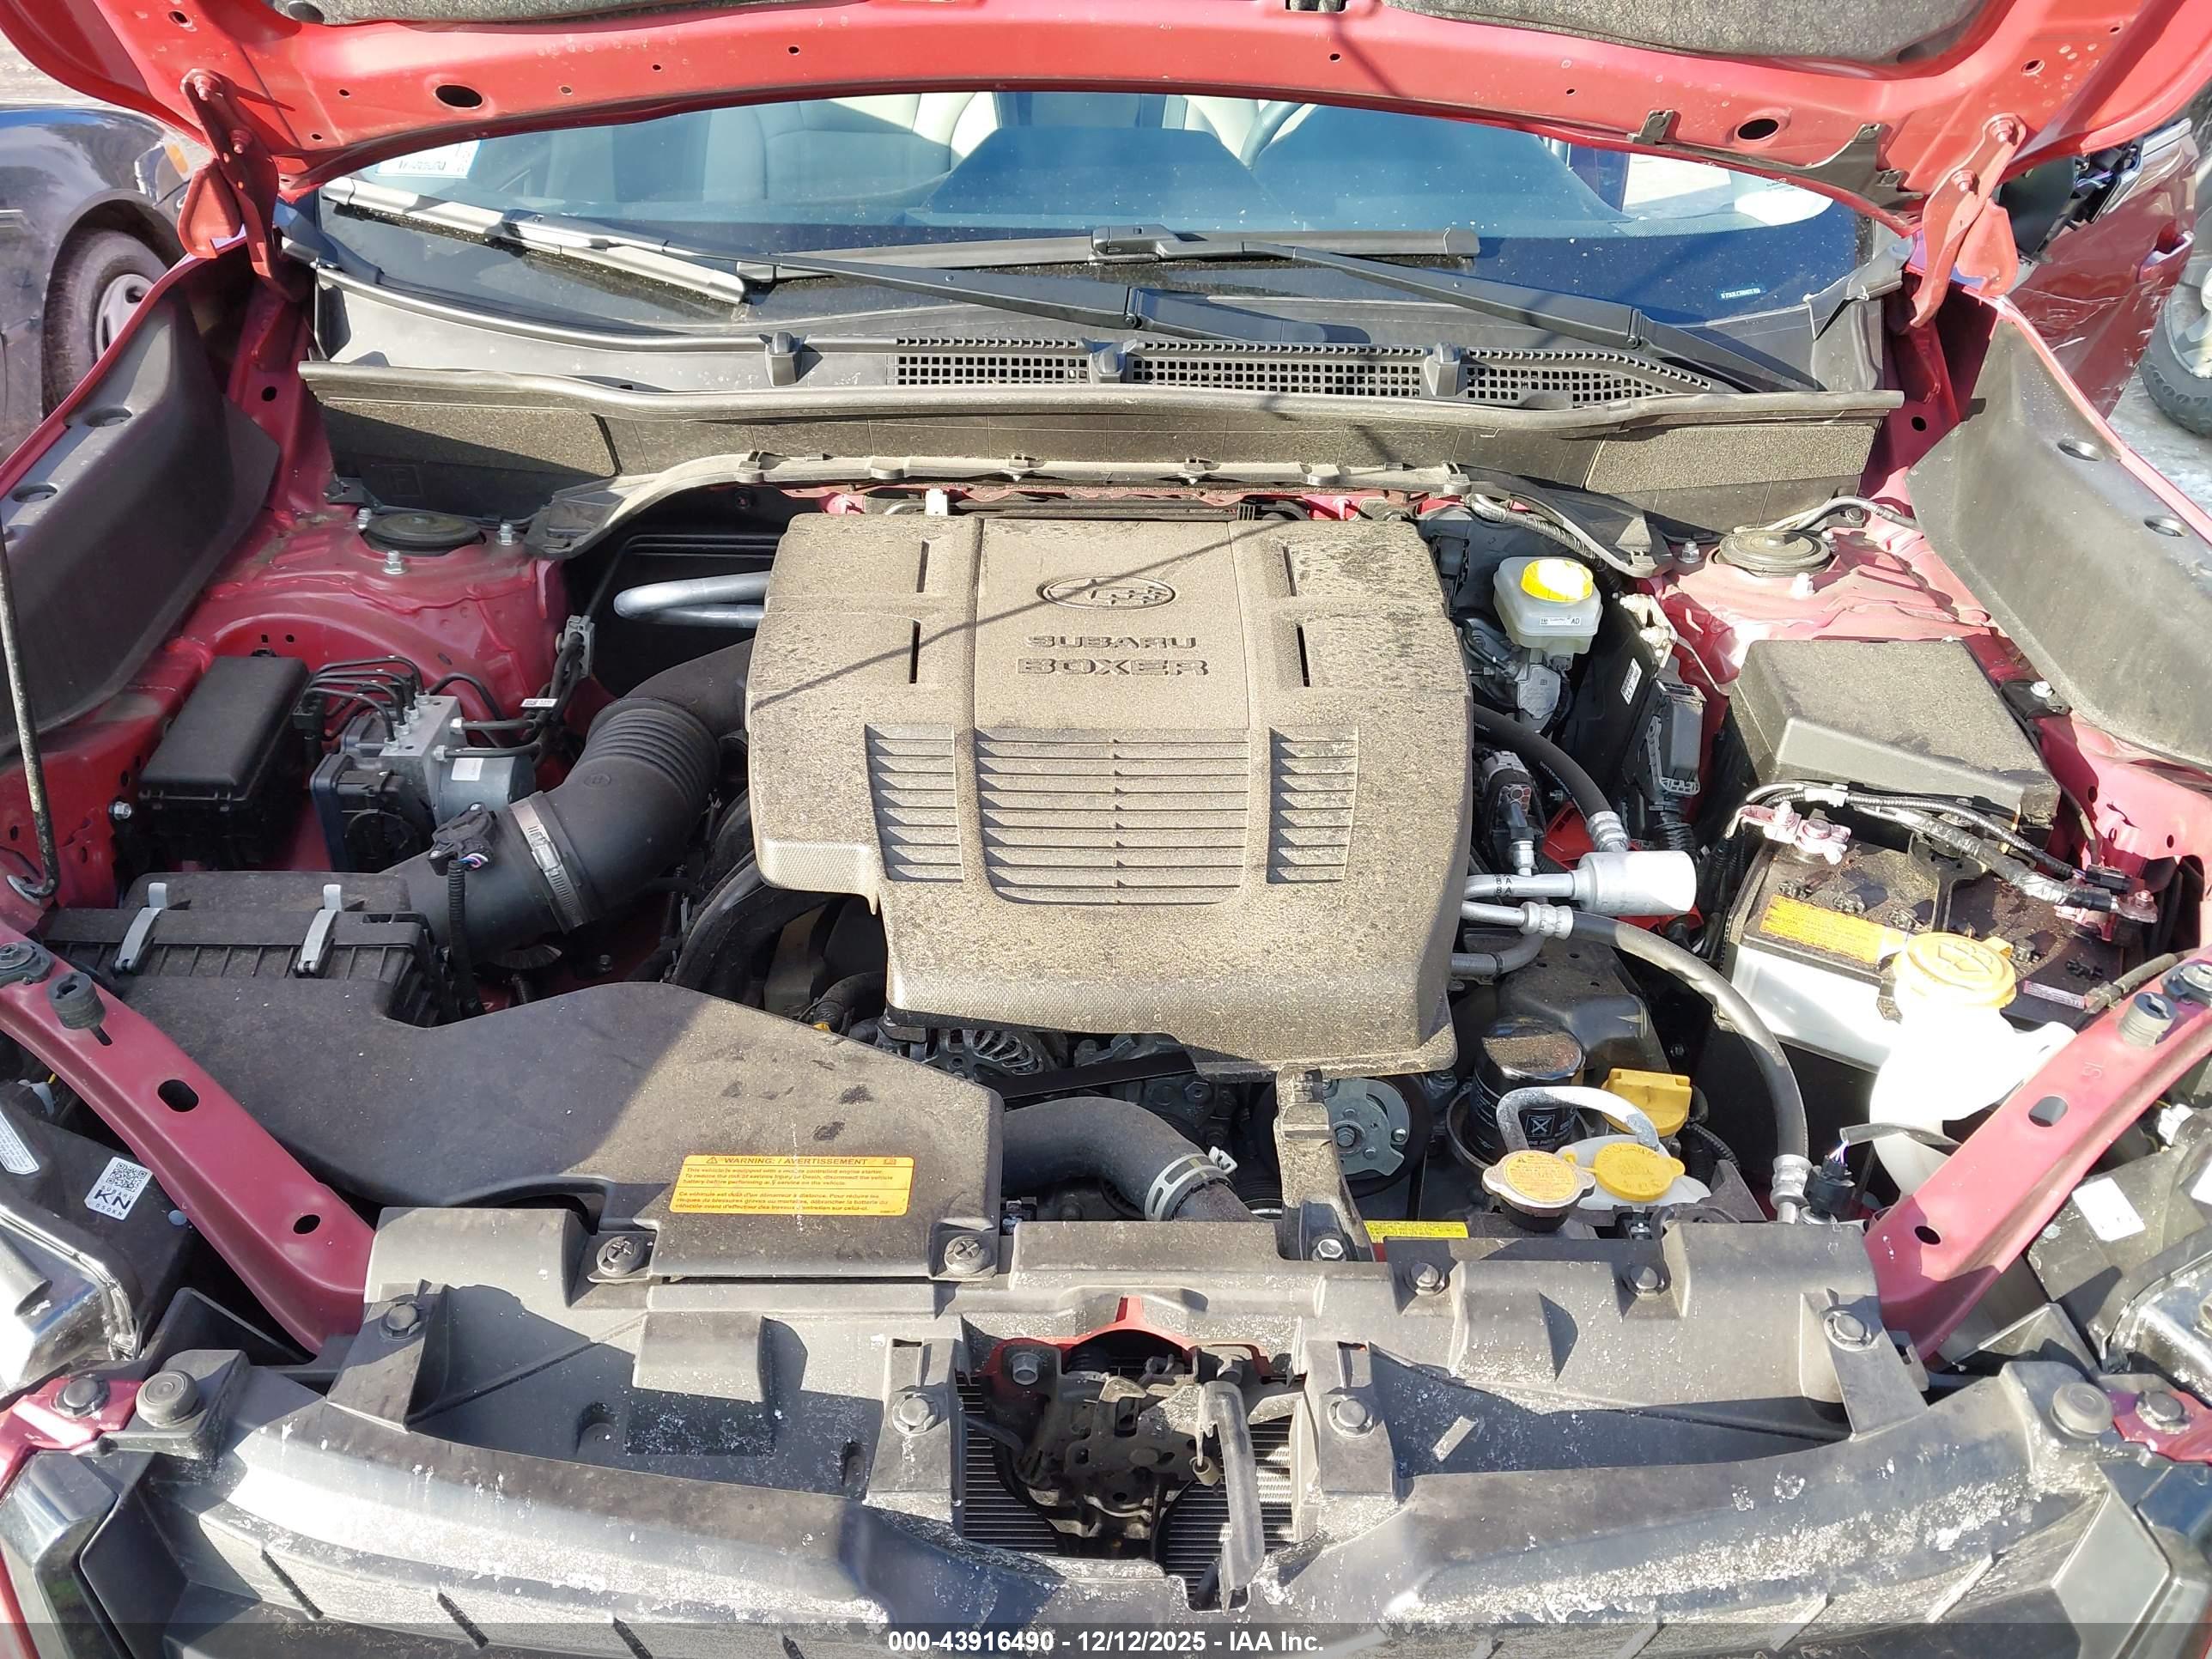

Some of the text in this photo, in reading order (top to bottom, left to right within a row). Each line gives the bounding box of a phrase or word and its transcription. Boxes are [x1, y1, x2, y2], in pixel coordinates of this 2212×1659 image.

[1027, 635, 1197, 649] SUBARU
[1017, 658, 1210, 676] BOXER
[94, 1189, 131, 1210] KN
[100, 1185, 135, 1200] SUBARU
